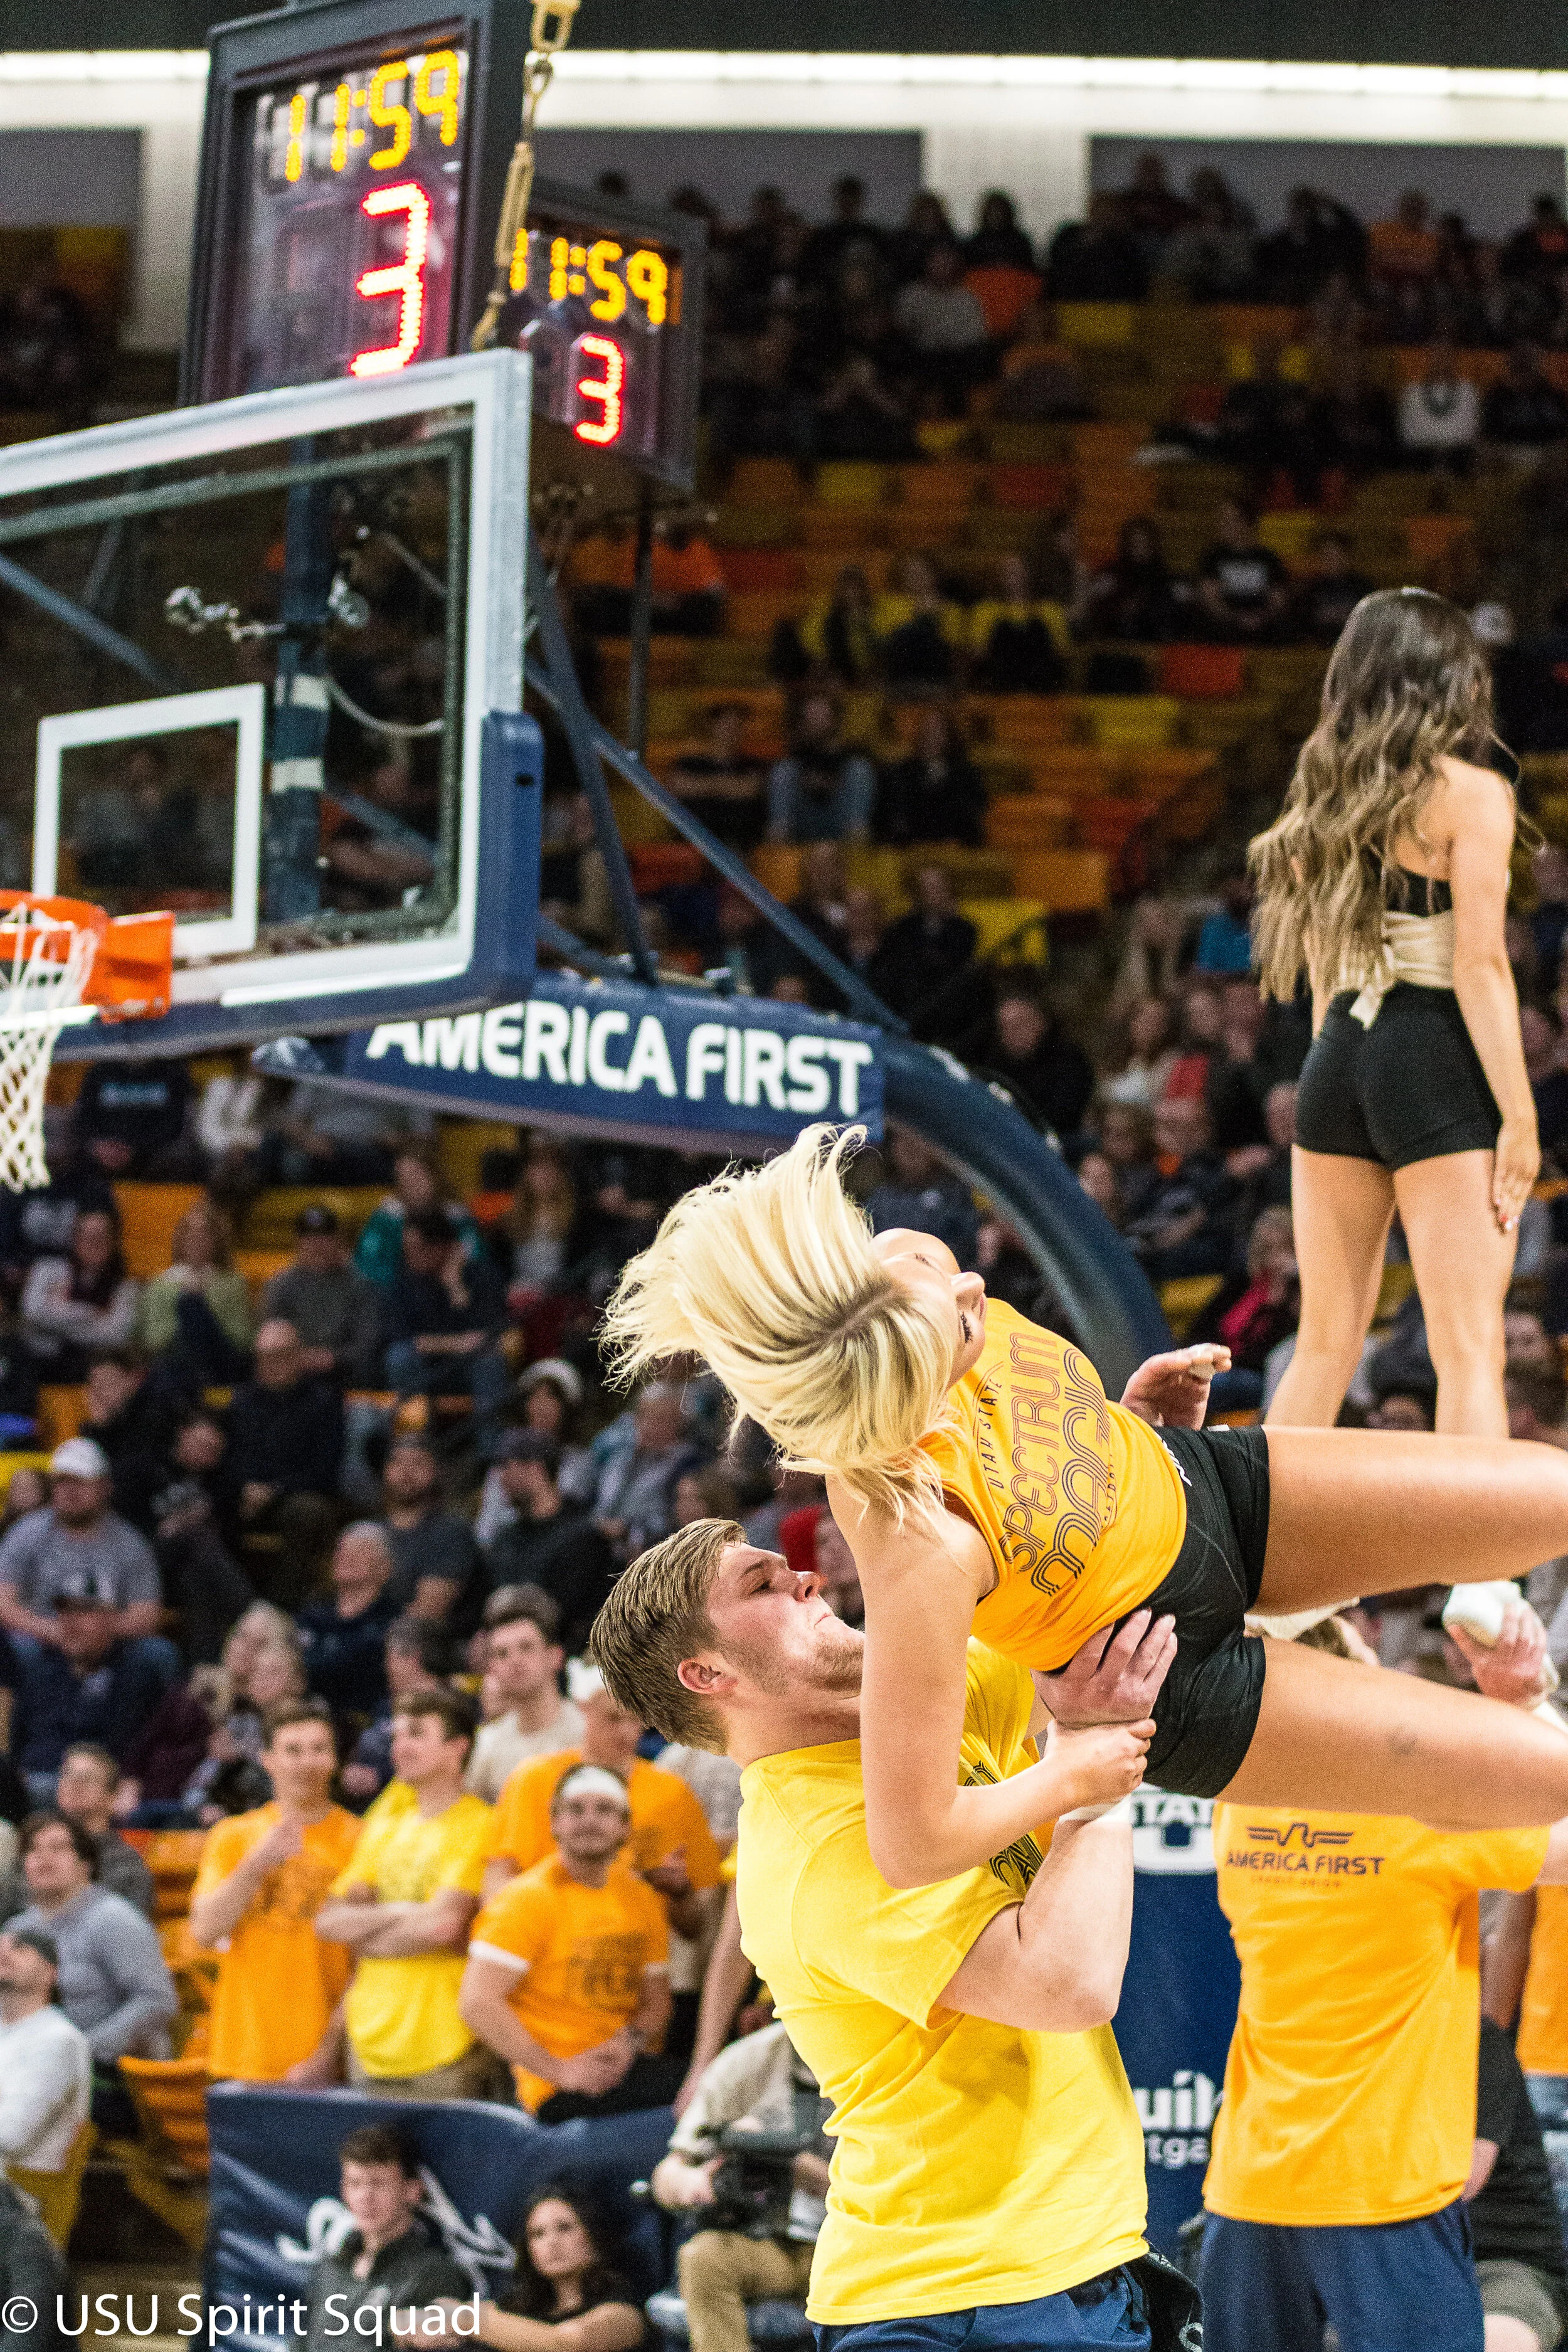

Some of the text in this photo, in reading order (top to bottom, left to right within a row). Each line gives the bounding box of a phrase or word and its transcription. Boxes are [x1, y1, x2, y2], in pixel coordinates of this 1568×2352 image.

[285, 50, 459, 181] 11:59
[351, 182, 428, 378] 3
[510, 228, 667, 324] 11:59
[575, 335, 623, 445] 3
[366, 1000, 874, 1116] AMERICA FIRST
[978, 1376, 1004, 1489] UTAH STATE
[999, 1332, 1059, 1574] SPECTRUM
[1226, 1850, 1385, 1875] AMERICA FIRST
[1133, 2070, 1224, 2131] uil
